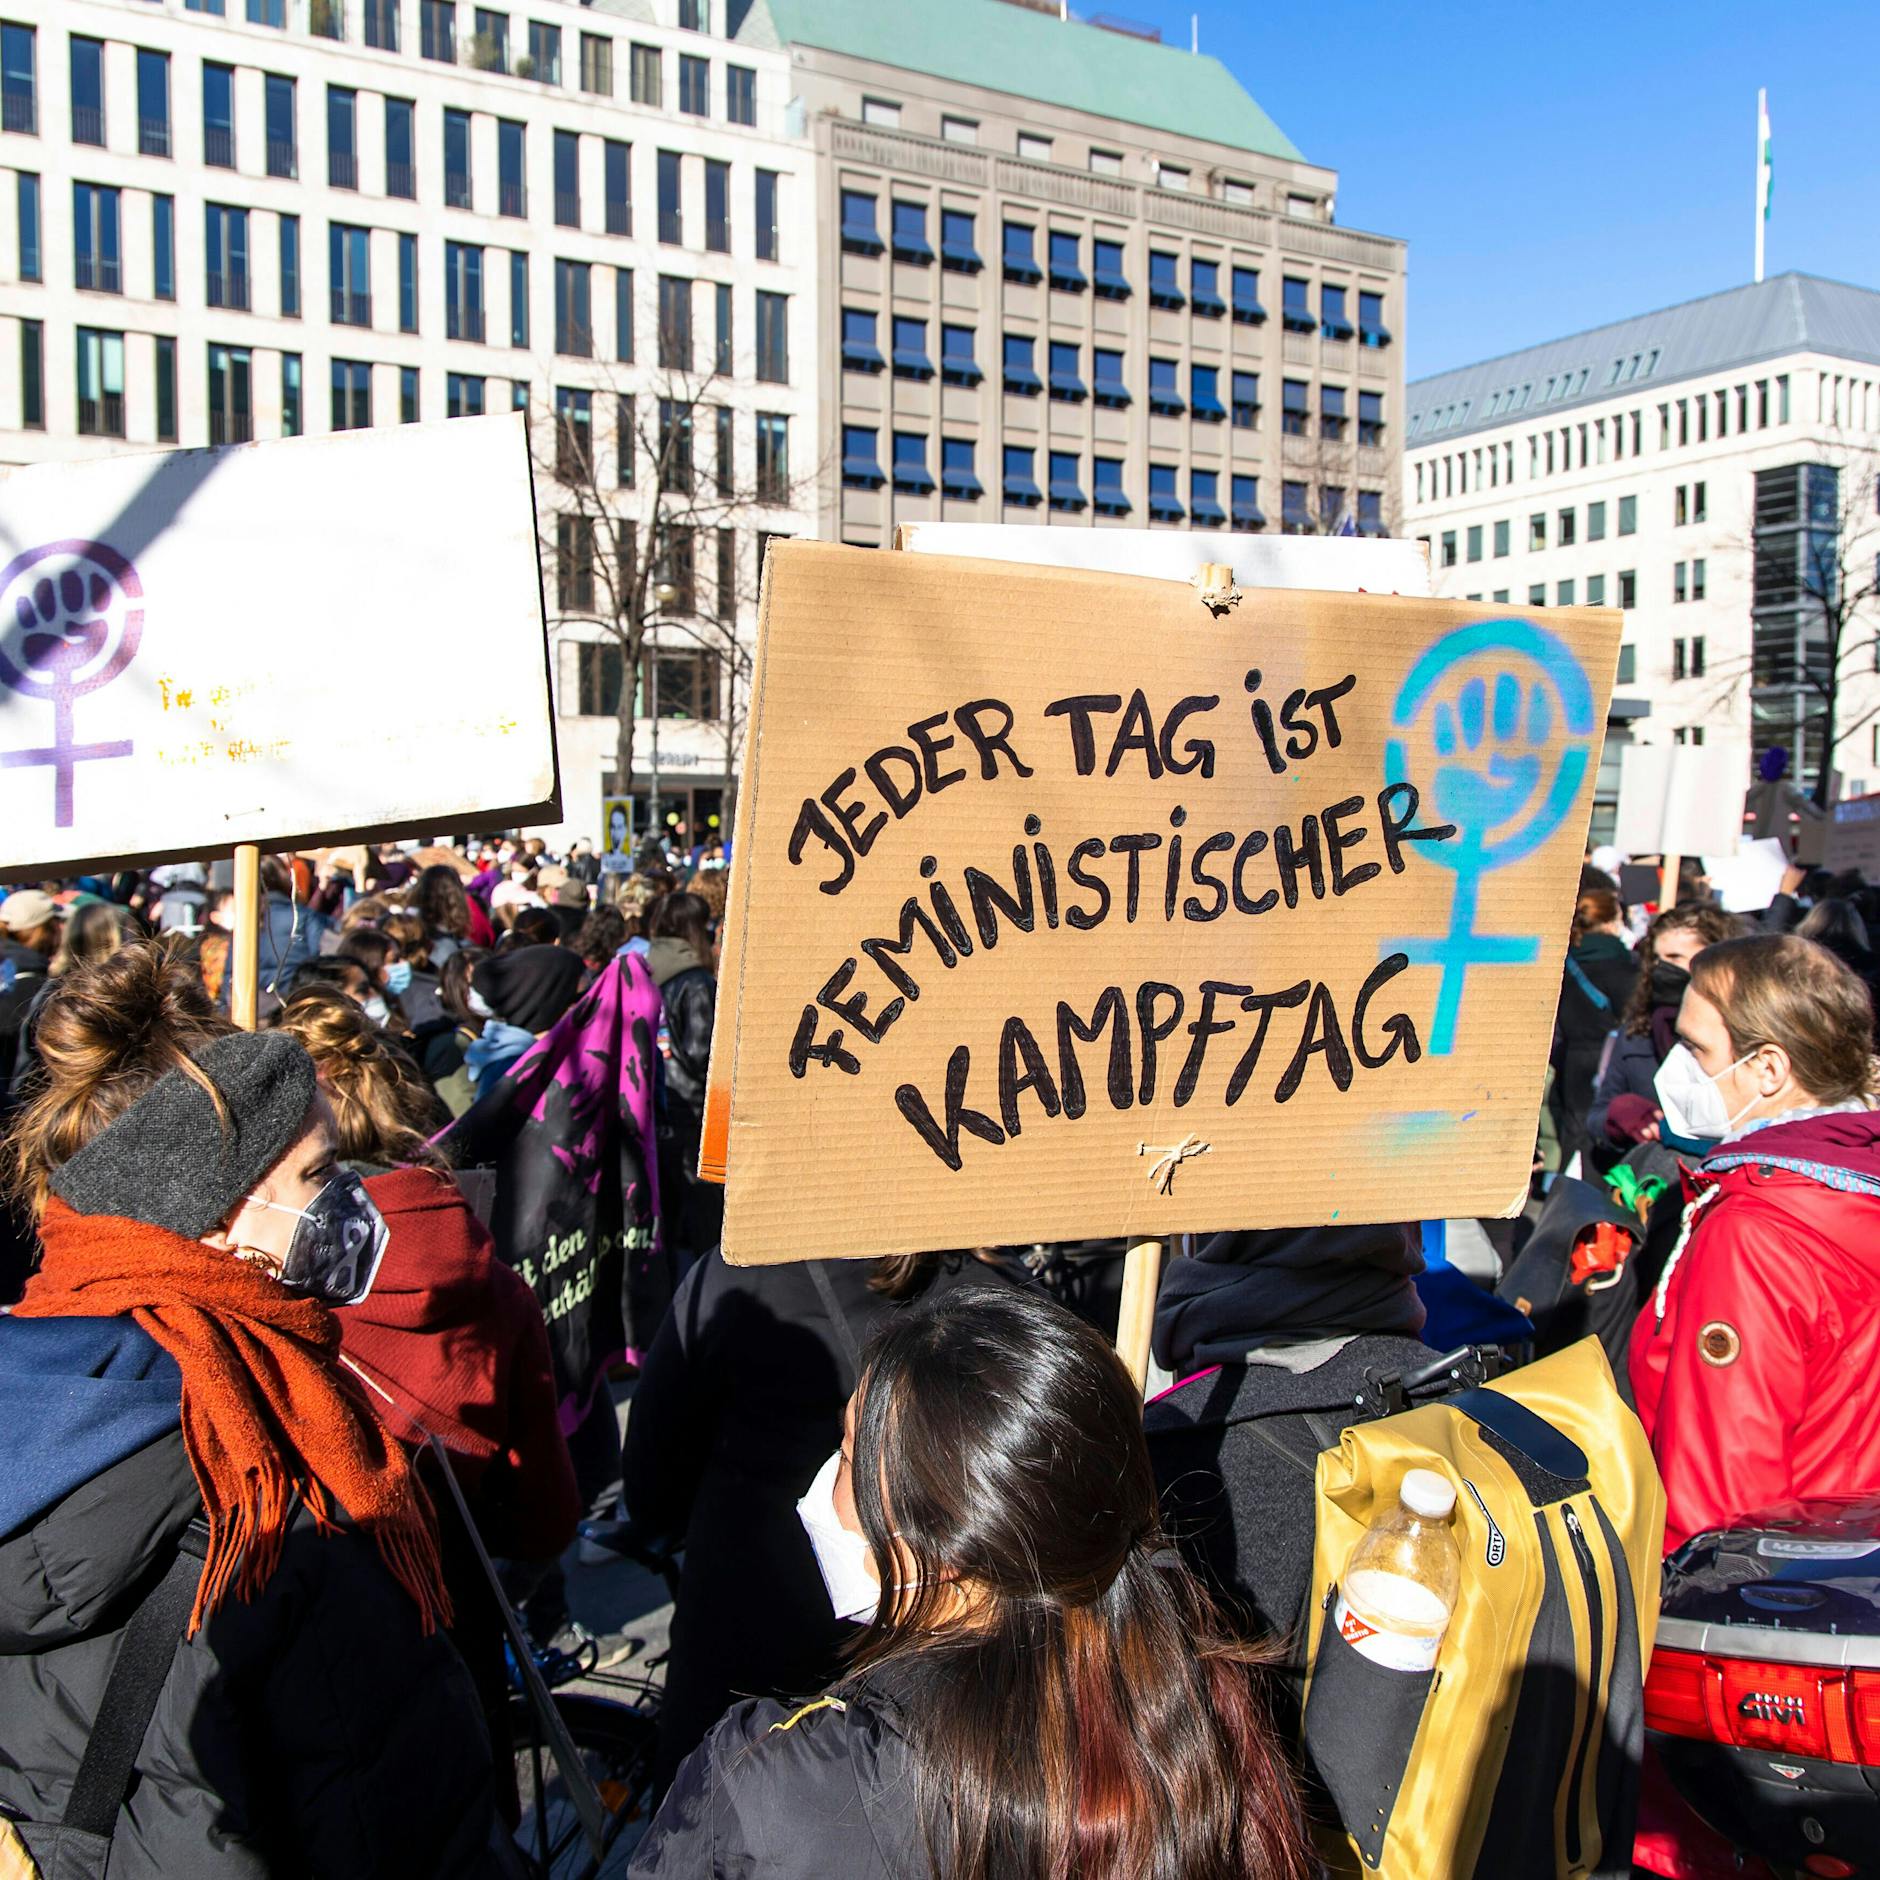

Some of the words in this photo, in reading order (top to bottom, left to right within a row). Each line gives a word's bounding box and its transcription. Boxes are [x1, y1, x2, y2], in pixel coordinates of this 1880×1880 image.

[788, 698, 1034, 896] JEDER
[1044, 688, 1220, 779] TAG
[894, 953, 1422, 1172] KAMPFTAG
[541, 1228, 588, 1275] den
[1738, 1692, 1805, 1726] GIVI
